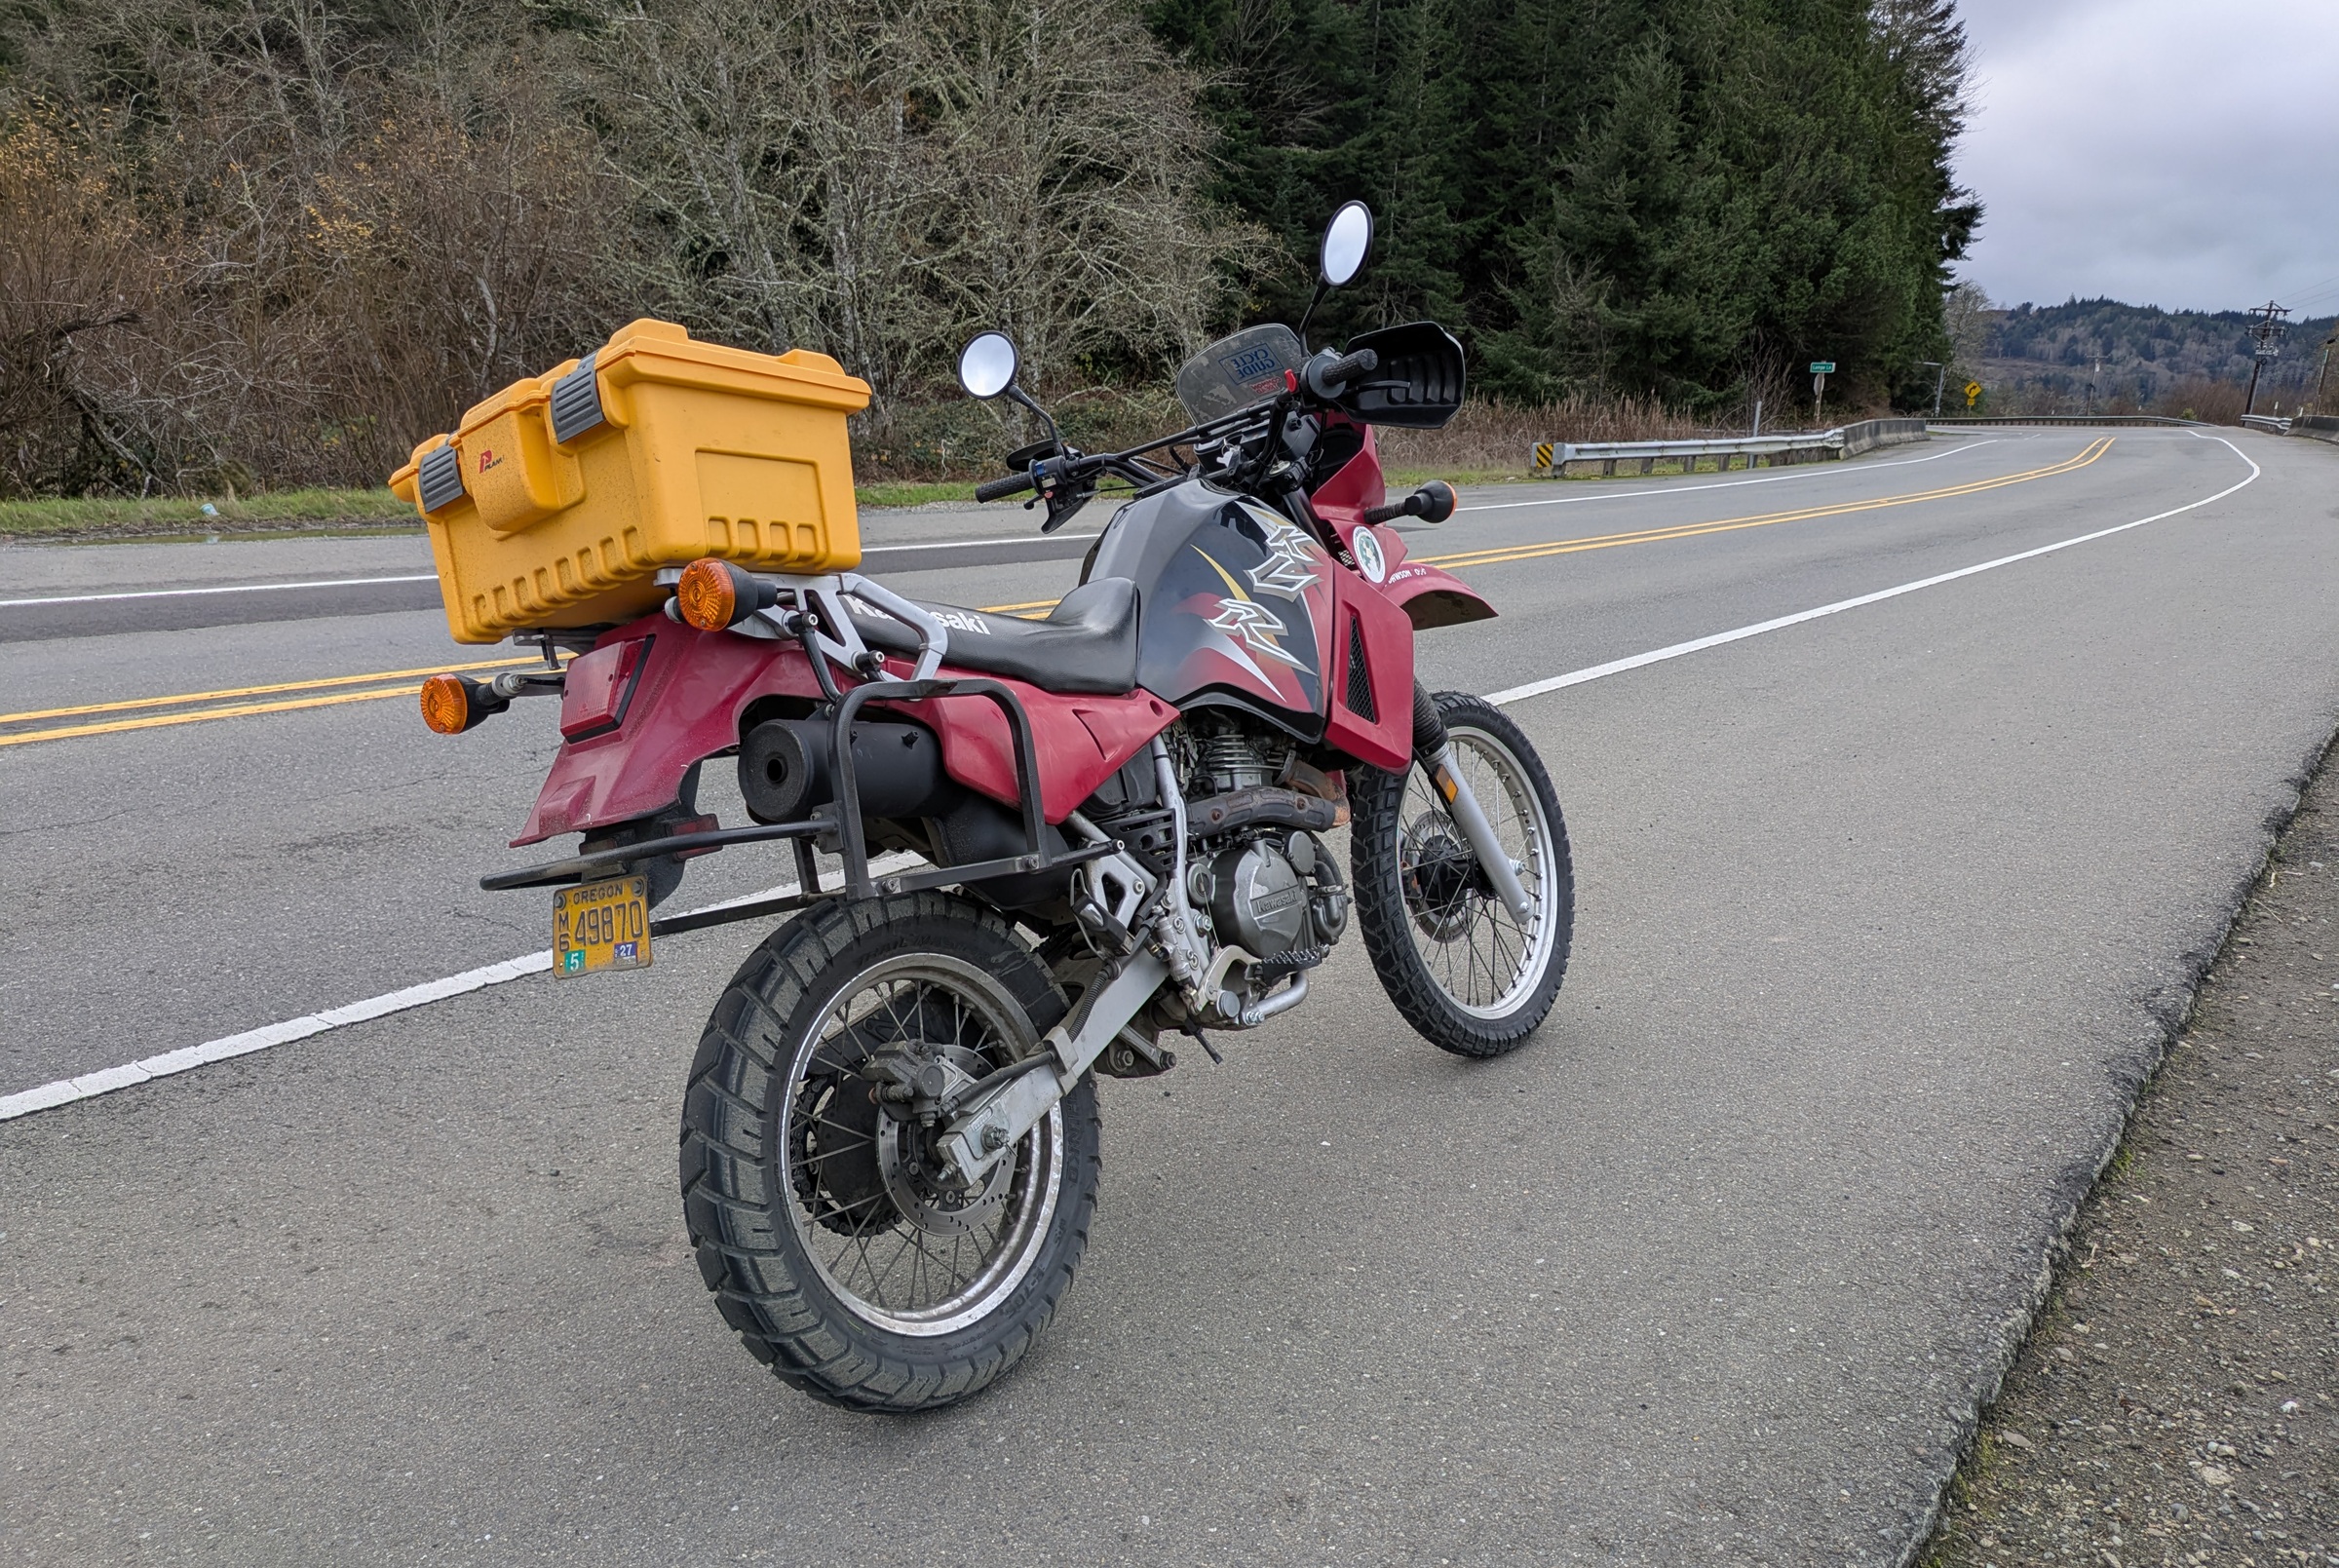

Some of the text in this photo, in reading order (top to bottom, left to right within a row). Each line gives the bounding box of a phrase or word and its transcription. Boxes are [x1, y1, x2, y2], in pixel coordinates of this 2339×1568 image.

[573, 883, 624, 905] OREGON
[1256, 889, 1298, 913] Kawasaki
[575, 900, 643, 946] 49870
[619, 943, 633, 957] 27
[569, 953, 579, 972] 5
